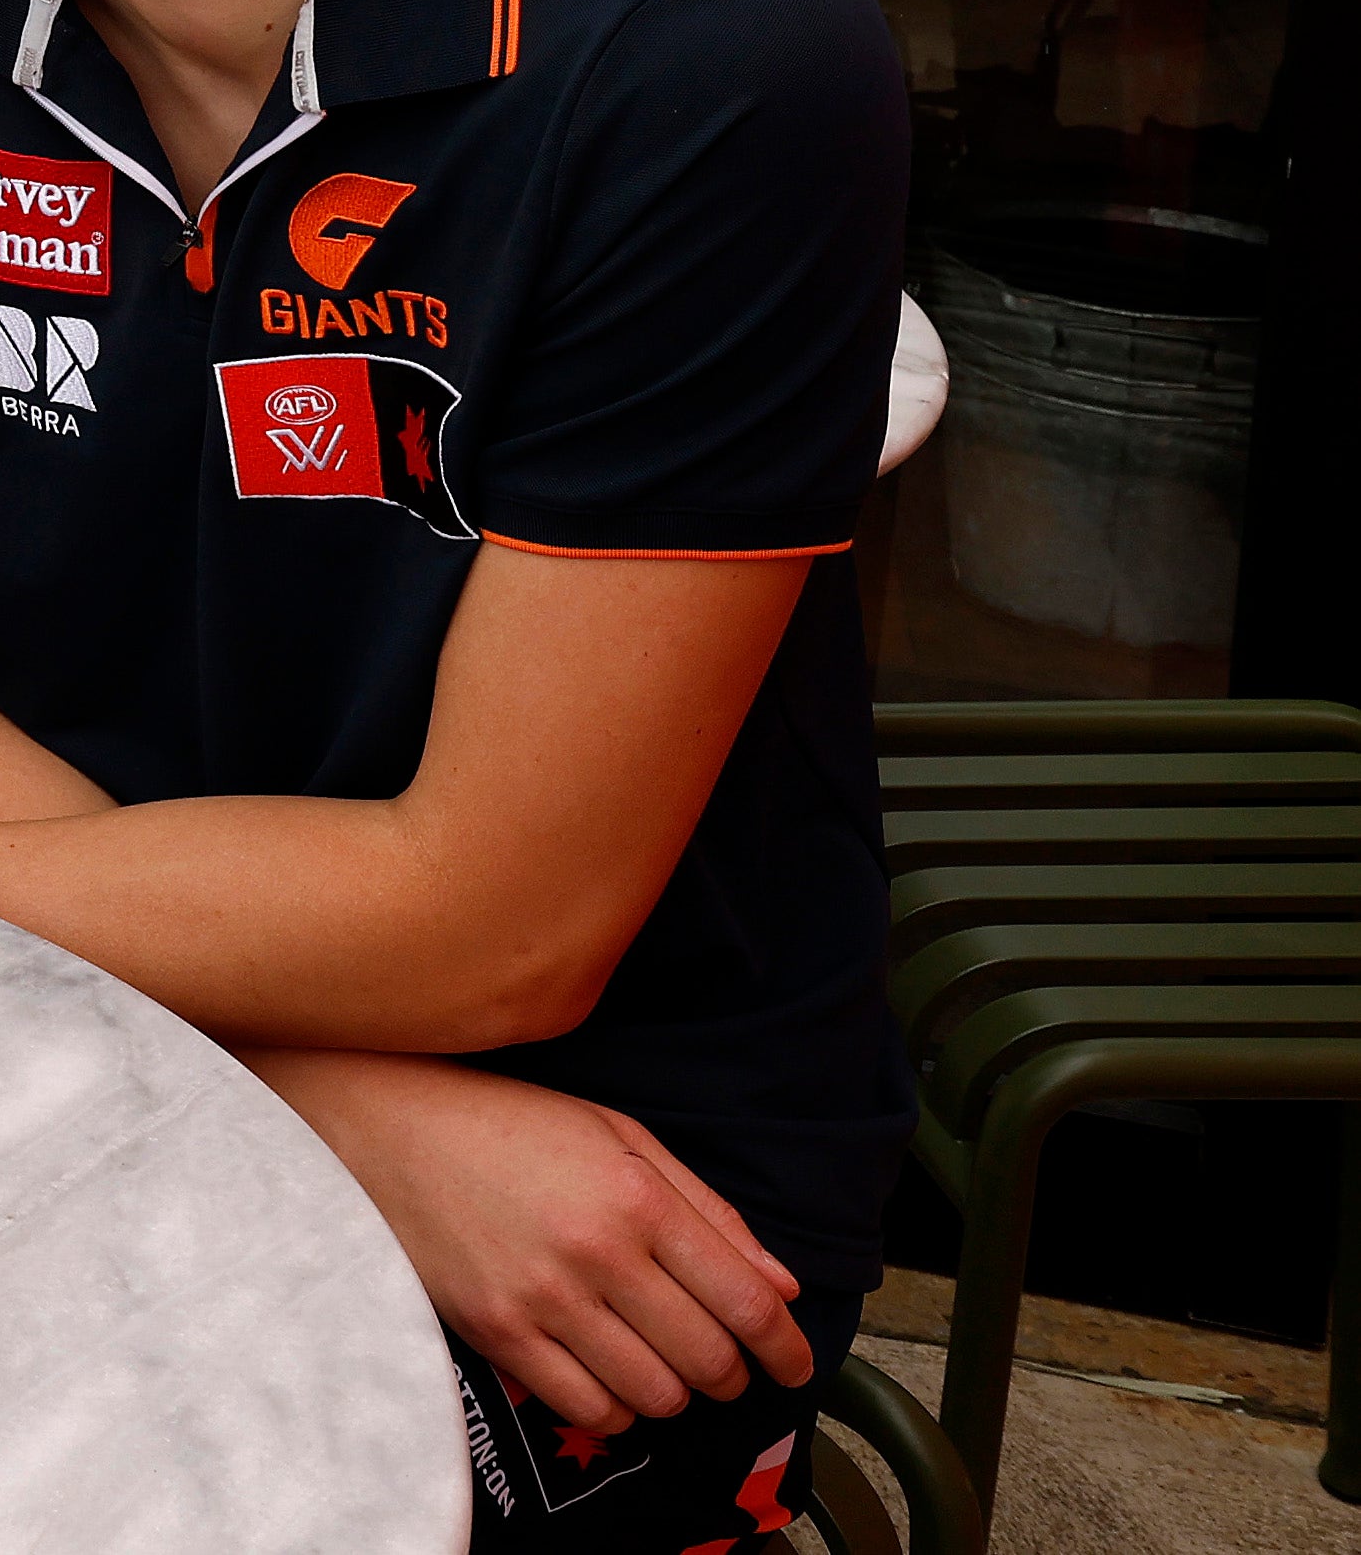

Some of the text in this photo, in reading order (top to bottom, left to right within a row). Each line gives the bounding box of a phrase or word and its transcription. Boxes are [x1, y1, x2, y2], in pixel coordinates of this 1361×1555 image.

[260, 288, 447, 348] GIANTS
[276, 395, 328, 416] AFL
[452, 1362, 516, 1519] OTTON:ON
